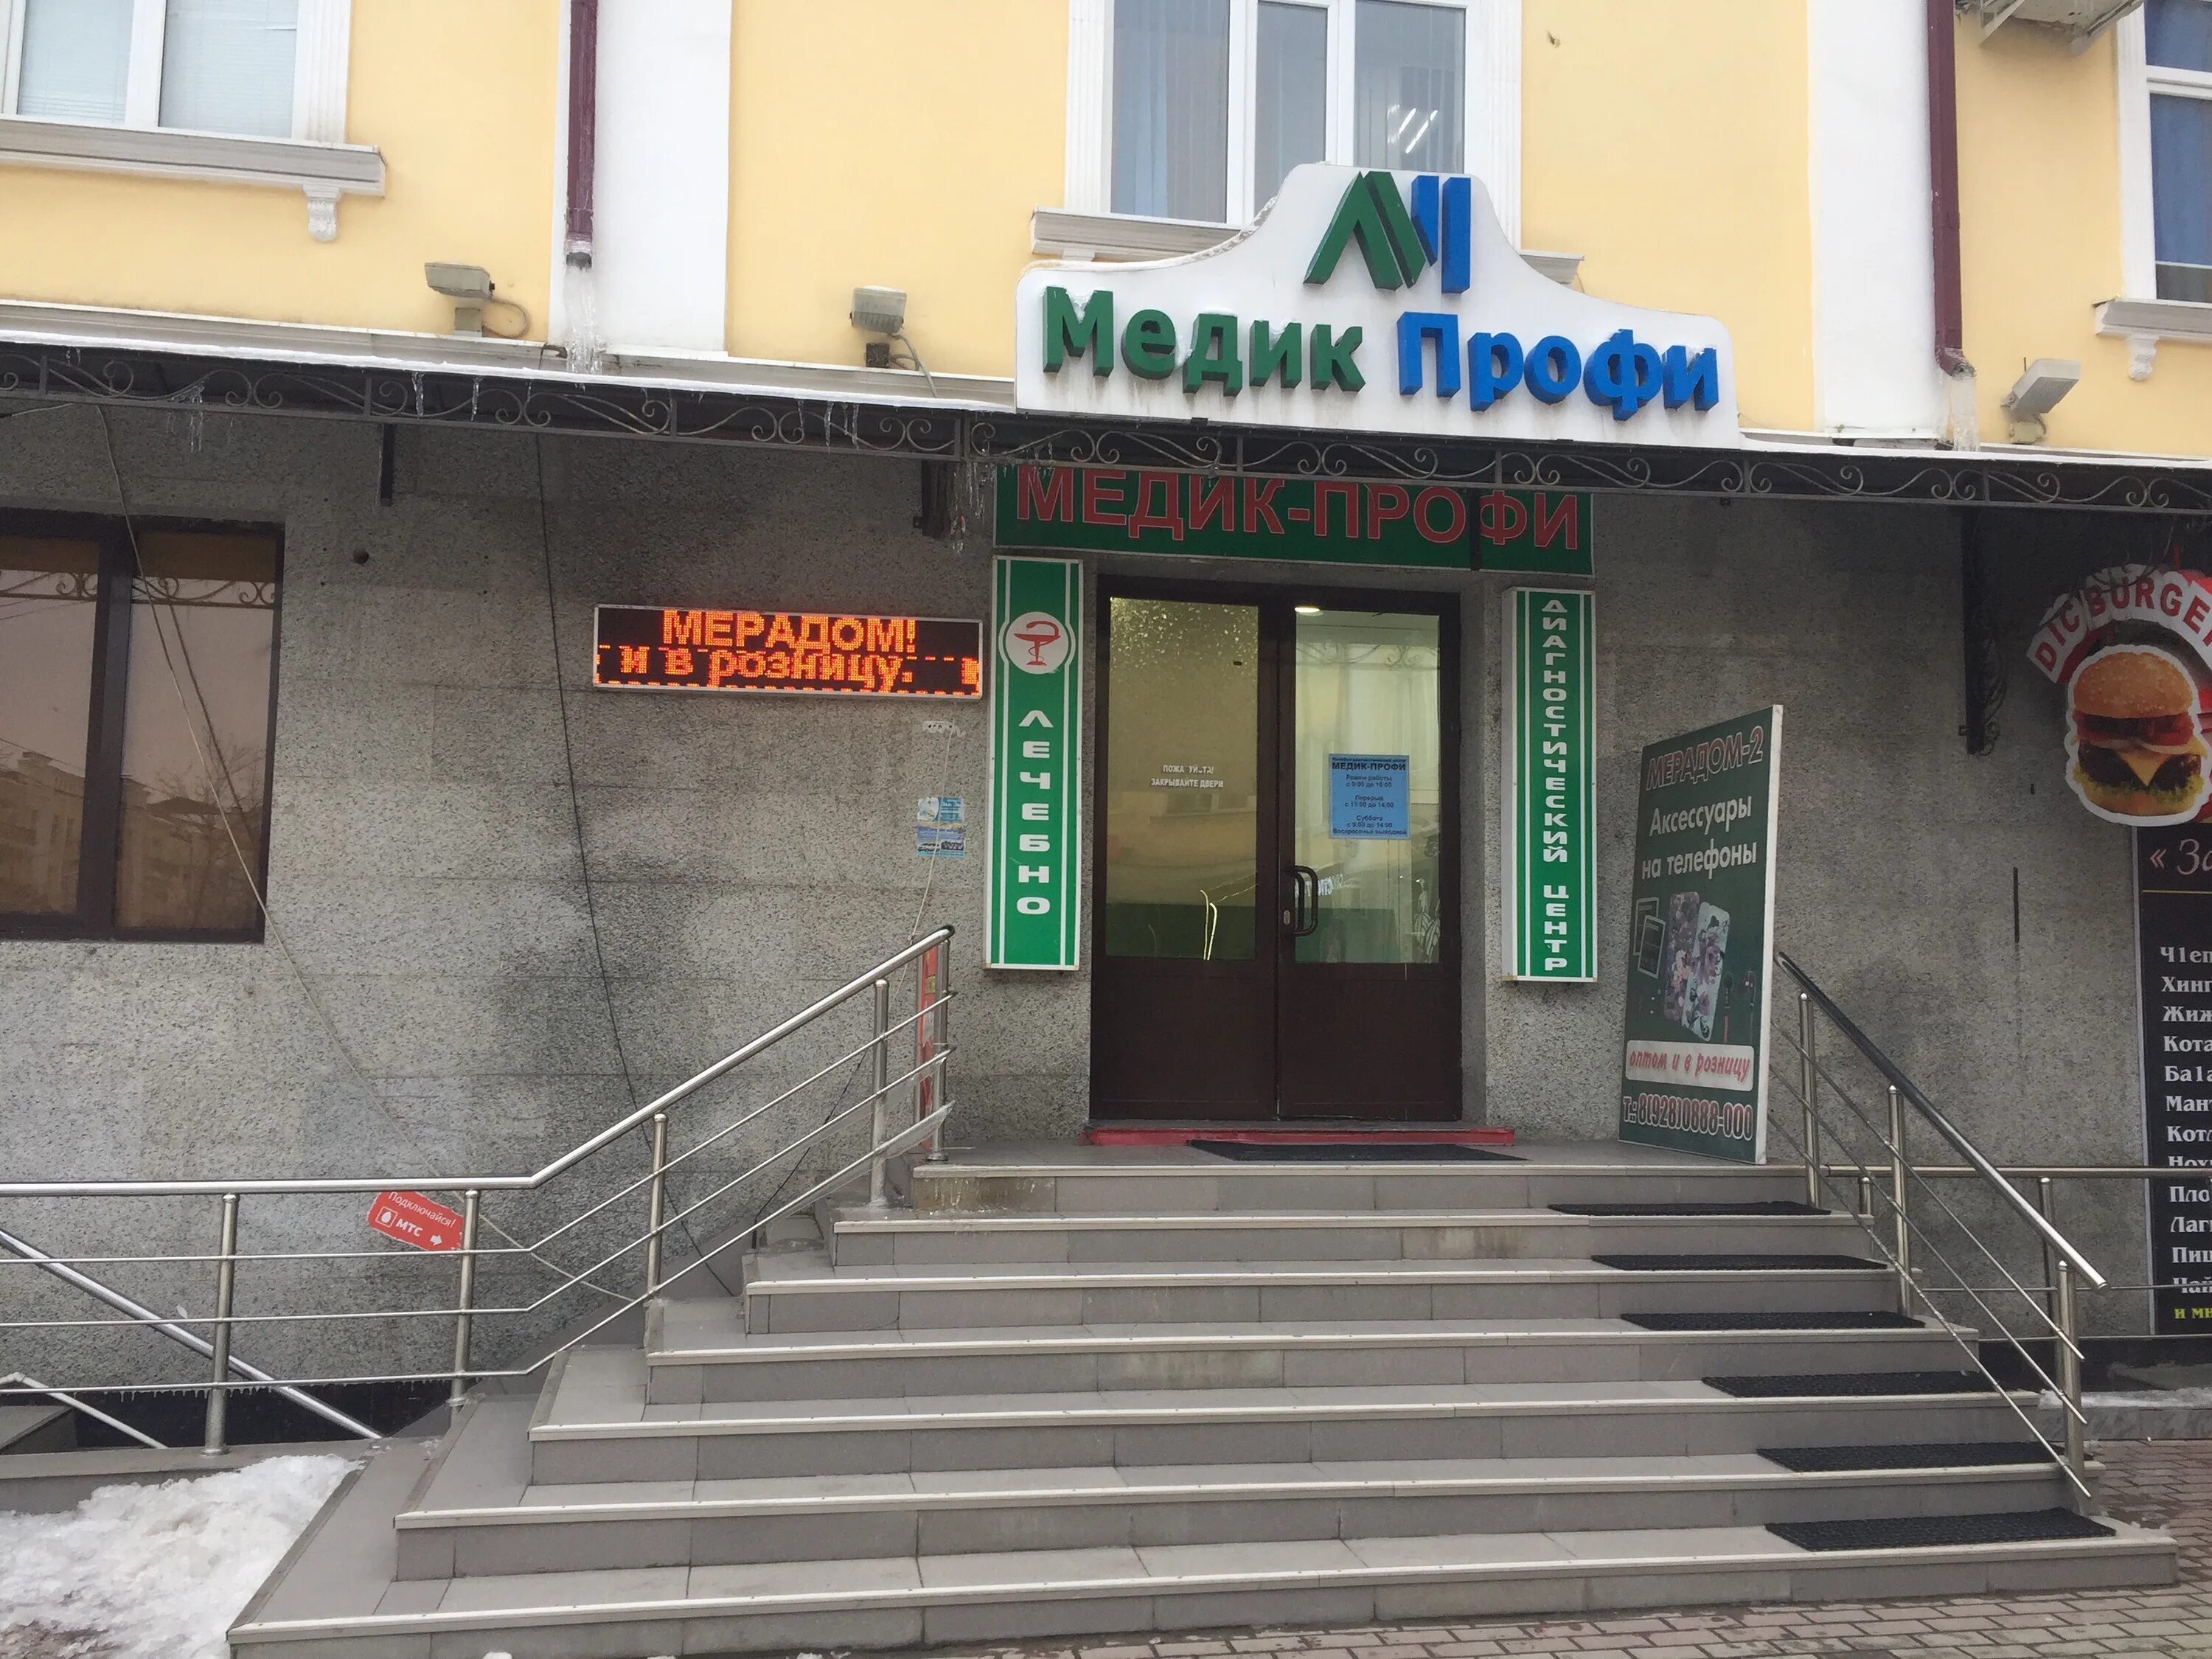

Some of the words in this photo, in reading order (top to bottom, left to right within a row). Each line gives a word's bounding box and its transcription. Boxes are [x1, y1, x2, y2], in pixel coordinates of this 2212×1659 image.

[1043, 287, 1366, 397] Медик
[1397, 310, 1719, 421] Профи
[1017, 464, 1578, 550] МЕДИК-ПРОФИ
[664, 609, 917, 654] МЕРАДОМ!
[1542, 599, 1568, 863] ДИАГНОСТИЧЕСКИЙ
[1332, 762, 1406, 771] МЕДИК-ПРОФИ
[1646, 726, 1764, 791] МЕРАДОМ-2
[1151, 778, 1198, 787] ЗАКРЫВАЙТЕ
[1200, 779, 1224, 789] ДВЕРИ
[1016, 709, 1054, 916] ЛЕЧЕБНО
[1649, 796, 1752, 836] Аксессуары
[1642, 857, 1661, 879] на
[1667, 838, 1757, 880] телефоны
[1544, 885, 1569, 971] ЦЕНТР
[1630, 1051, 1668, 1071] оптом
[1672, 1053, 1680, 1071] и
[1684, 1054, 1692, 1072] в
[1694, 1053, 1750, 1083] розницу
[2166, 1096, 2212, 1112] Ман
[2168, 1155, 2212, 1166] Нох
[388, 1192, 456, 1228] Подключайся!
[395, 1218, 423, 1237] МТС
[2170, 1217, 2212, 1232] Лаг
[2174, 1308, 2185, 1319] и
